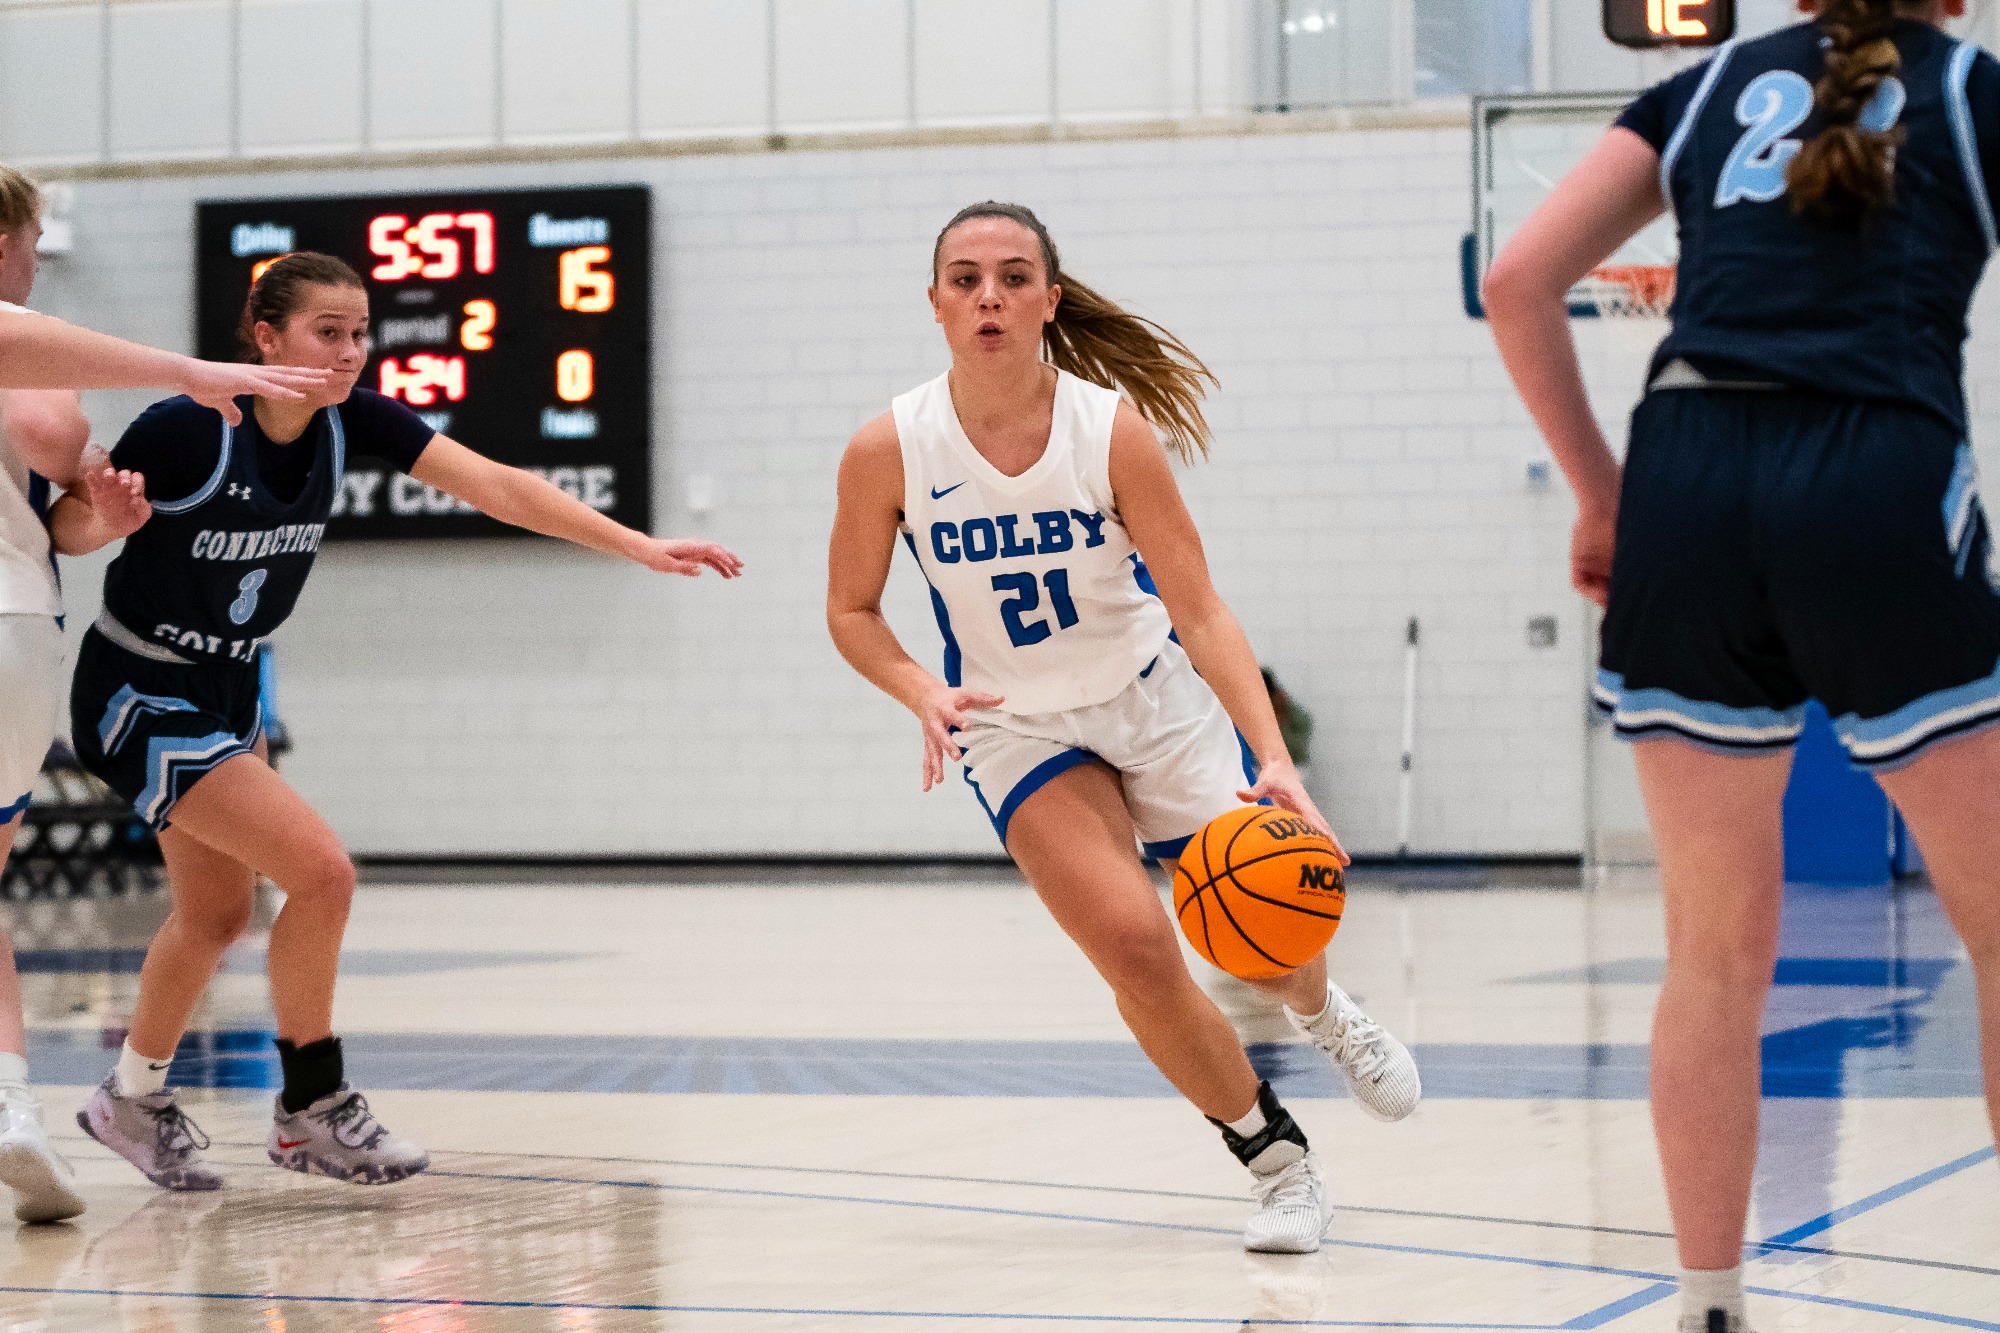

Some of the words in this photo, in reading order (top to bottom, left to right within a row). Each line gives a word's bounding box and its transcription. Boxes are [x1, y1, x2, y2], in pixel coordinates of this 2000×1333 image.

[369, 211, 495, 282] 5:57
[559, 246, 614, 312] 15
[461, 299, 496, 351] 2
[556, 349, 594, 402] 0
[931, 508, 1106, 564] COLBY
[229, 568, 268, 625] 3
[991, 568, 1080, 648] 21
